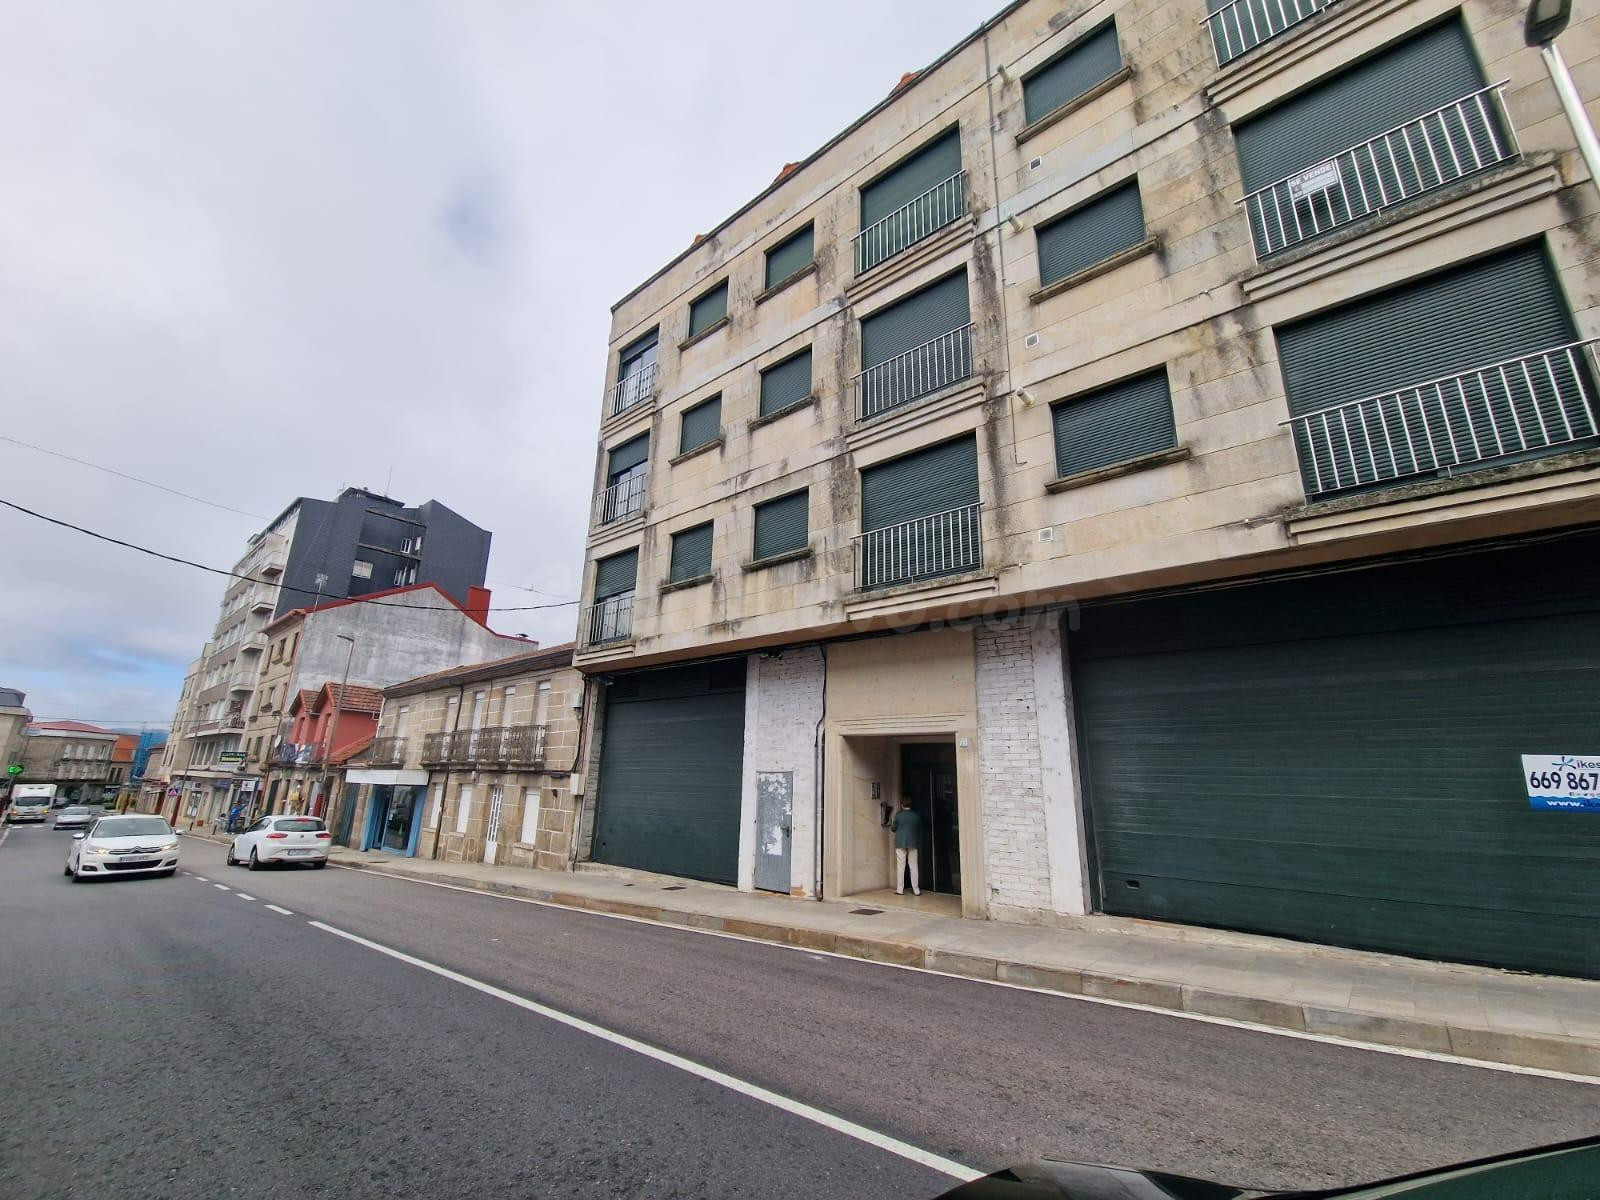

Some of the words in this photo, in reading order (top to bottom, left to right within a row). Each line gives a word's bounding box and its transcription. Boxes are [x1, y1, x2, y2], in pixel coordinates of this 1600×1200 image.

[1303, 164, 1332, 181] VENDE
[1530, 771, 1561, 789] 669
[1566, 772, 1599, 790] 867
